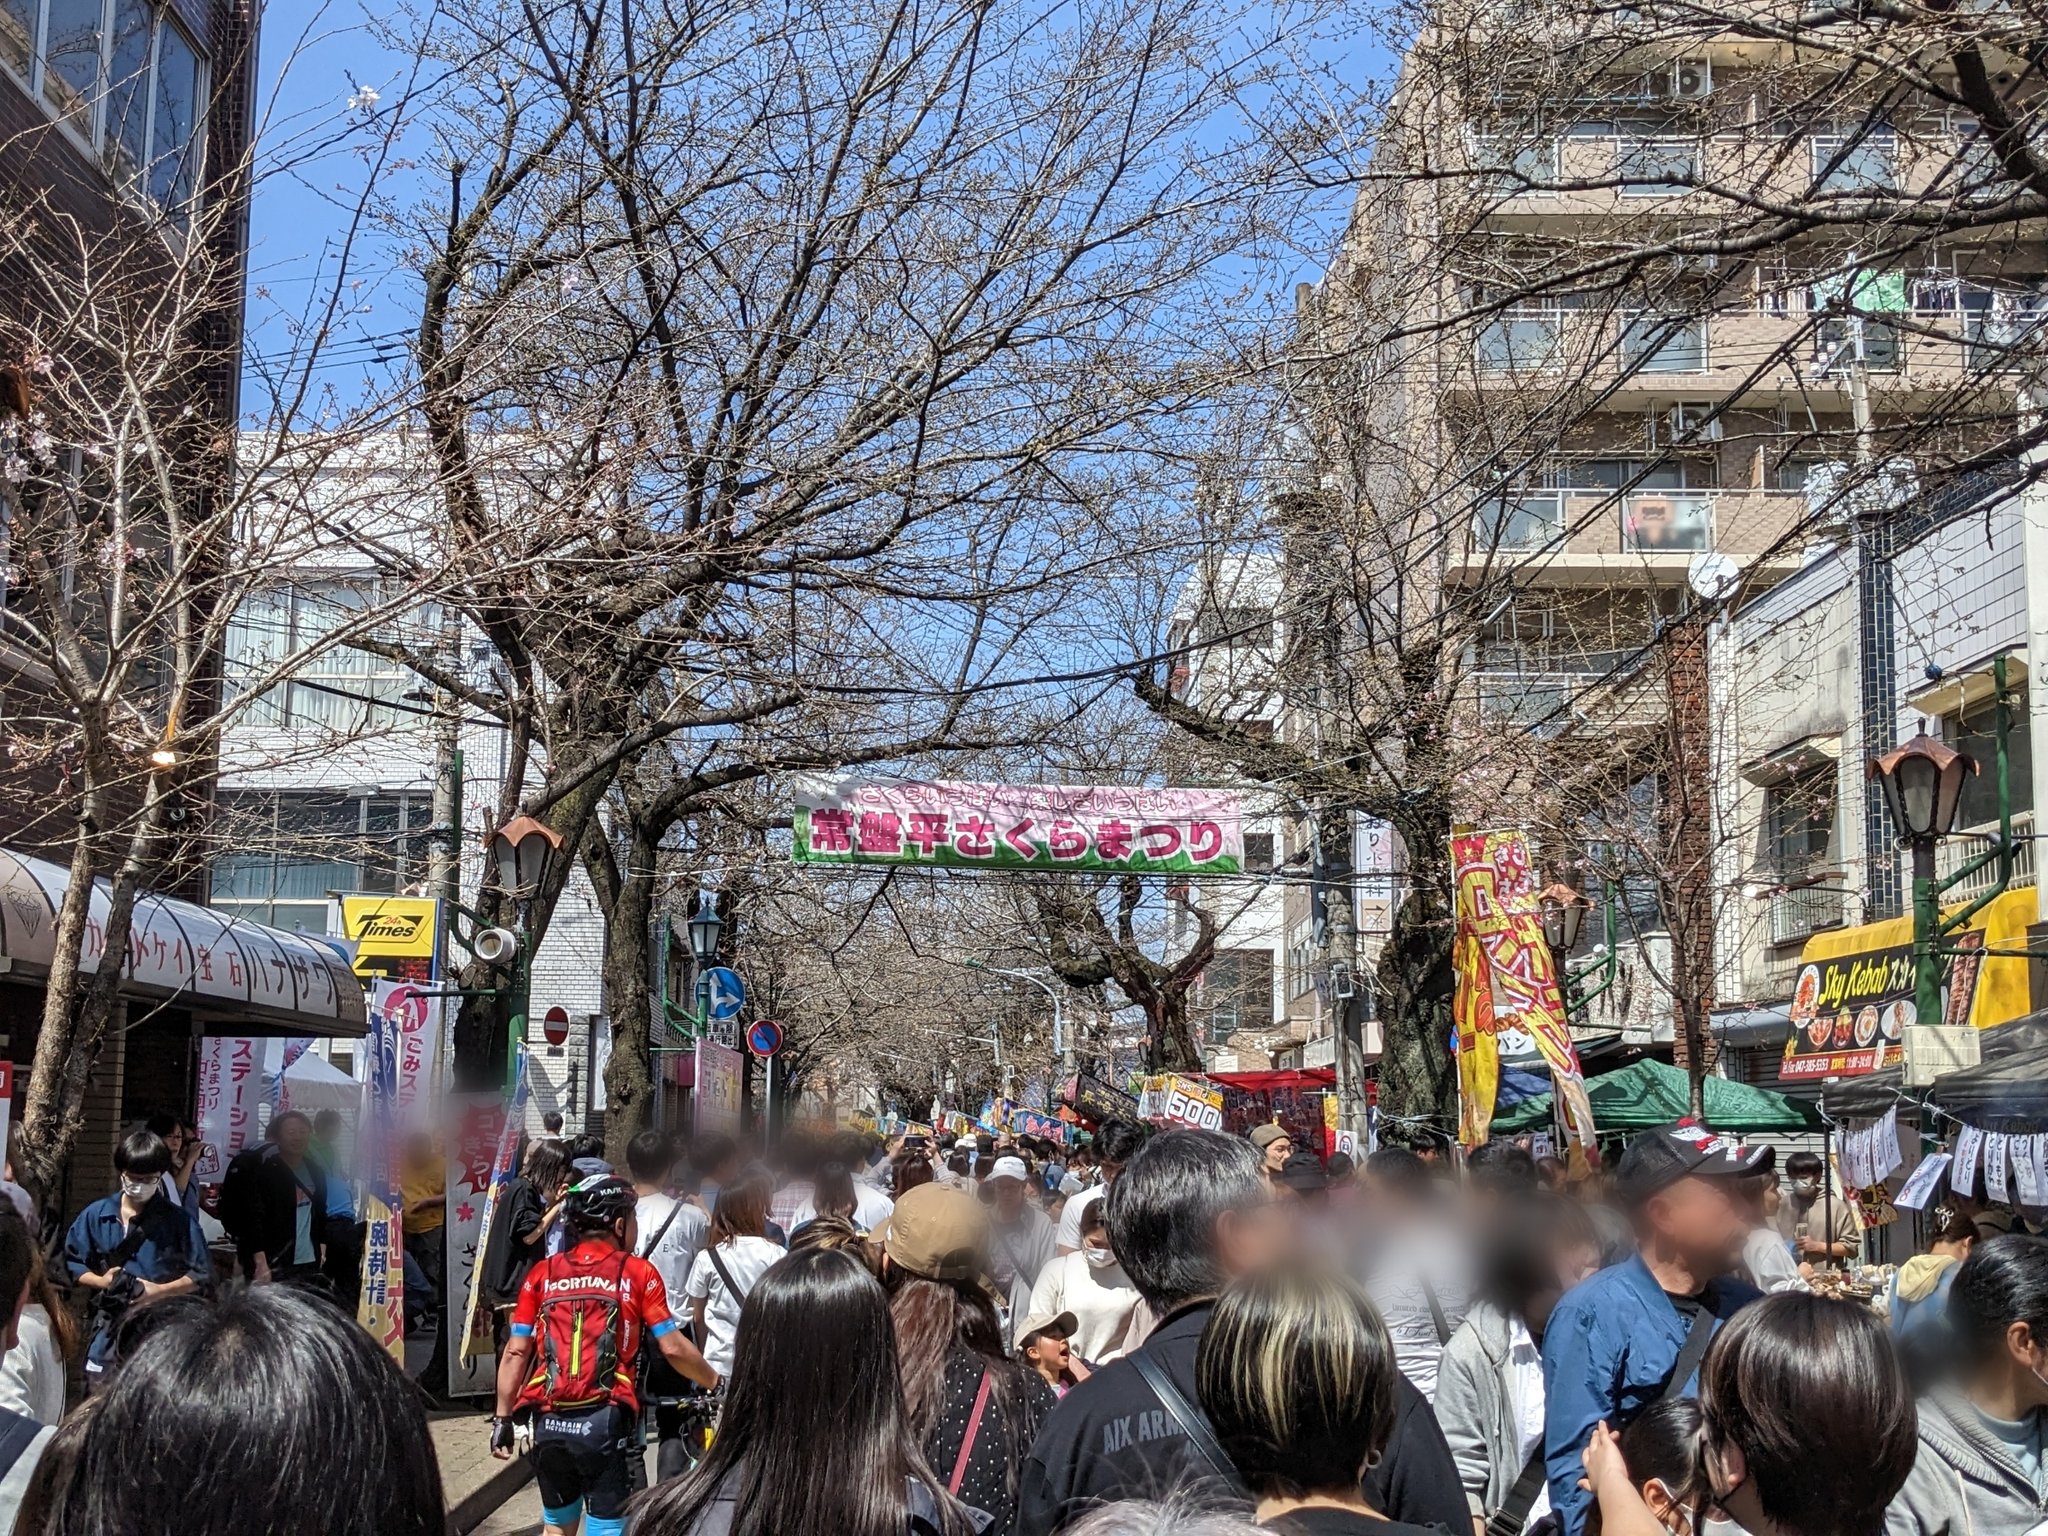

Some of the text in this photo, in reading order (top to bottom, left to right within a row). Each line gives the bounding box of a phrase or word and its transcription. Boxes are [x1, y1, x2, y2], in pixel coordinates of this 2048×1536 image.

[811, 808, 1225, 863] 常盤平さくらまつり
[356, 914, 424, 937] Times
[198, 943, 243, 987] 宝石
[245, 944, 334, 1005] ハナザワ
[1818, 964, 1847, 1008] Sky
[1846, 955, 1889, 1001] Kebab
